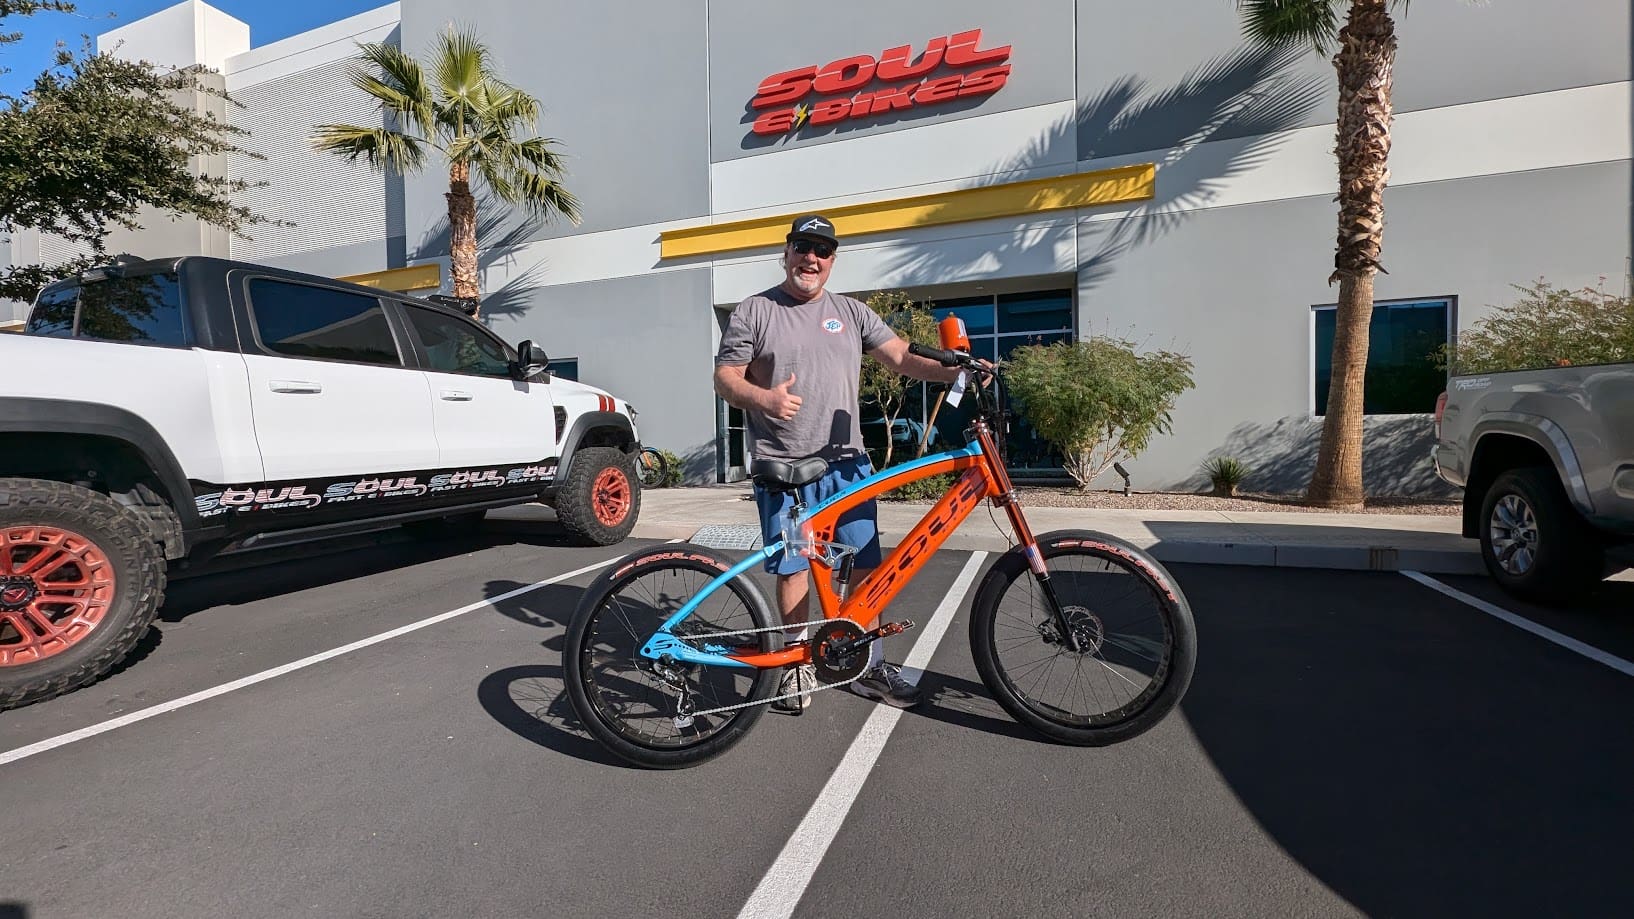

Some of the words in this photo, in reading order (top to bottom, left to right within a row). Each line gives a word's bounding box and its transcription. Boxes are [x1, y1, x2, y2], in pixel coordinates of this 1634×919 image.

[752, 28, 1012, 109] SOUL
[809, 64, 1012, 126] BIKES
[427, 470, 505, 488] SOUL
[505, 466, 558, 480] SOU
[194, 486, 322, 512] SOUL
[323, 477, 427, 498] SOUL
[866, 476, 990, 609] SOUL
